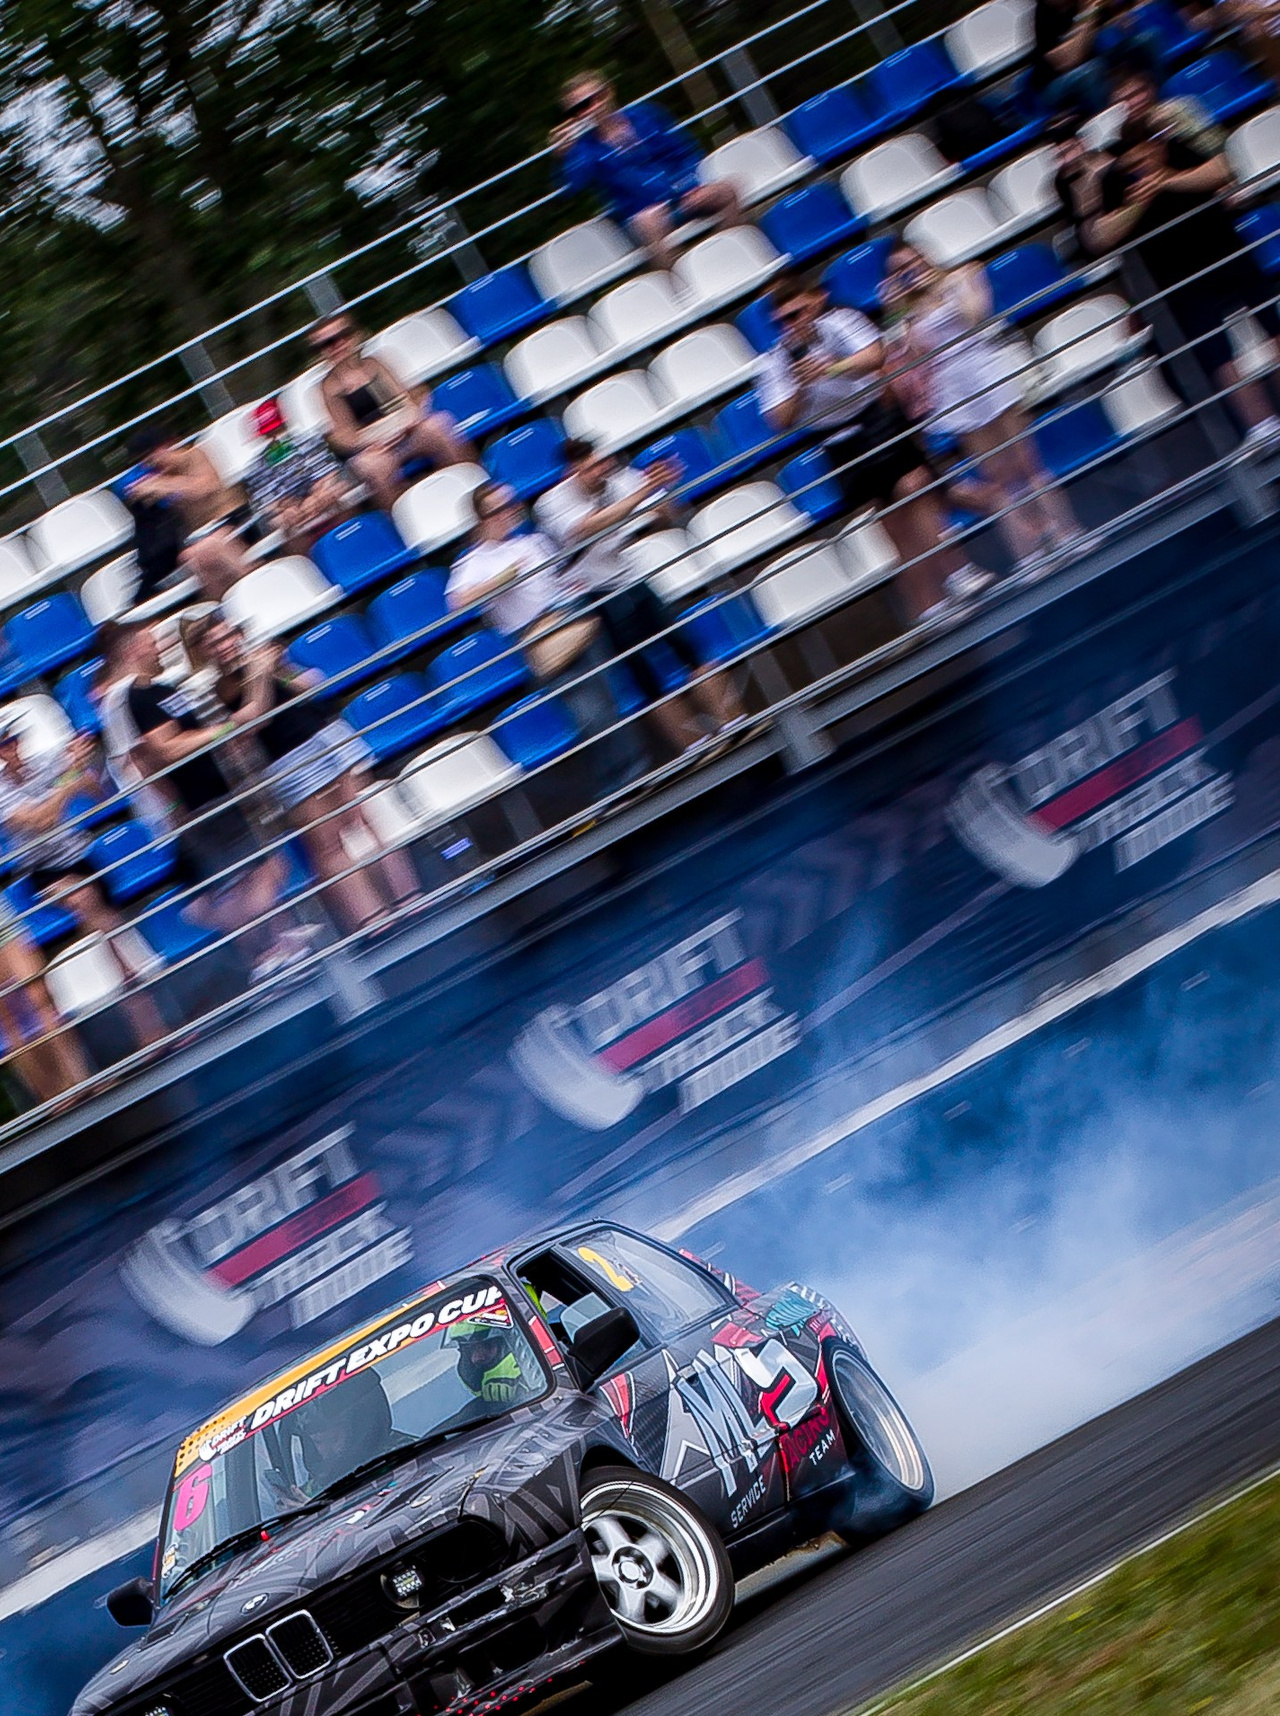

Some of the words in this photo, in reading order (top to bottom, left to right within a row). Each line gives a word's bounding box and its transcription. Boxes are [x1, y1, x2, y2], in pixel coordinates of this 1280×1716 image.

[249, 1357, 347, 1430] DRIFT
[346, 1312, 437, 1374] EXPO
[437, 1286, 502, 1327] CUP
[808, 1428, 837, 1467] TEAM
[173, 1463, 213, 1532] 6
[731, 1474, 766, 1529] SERVICE
